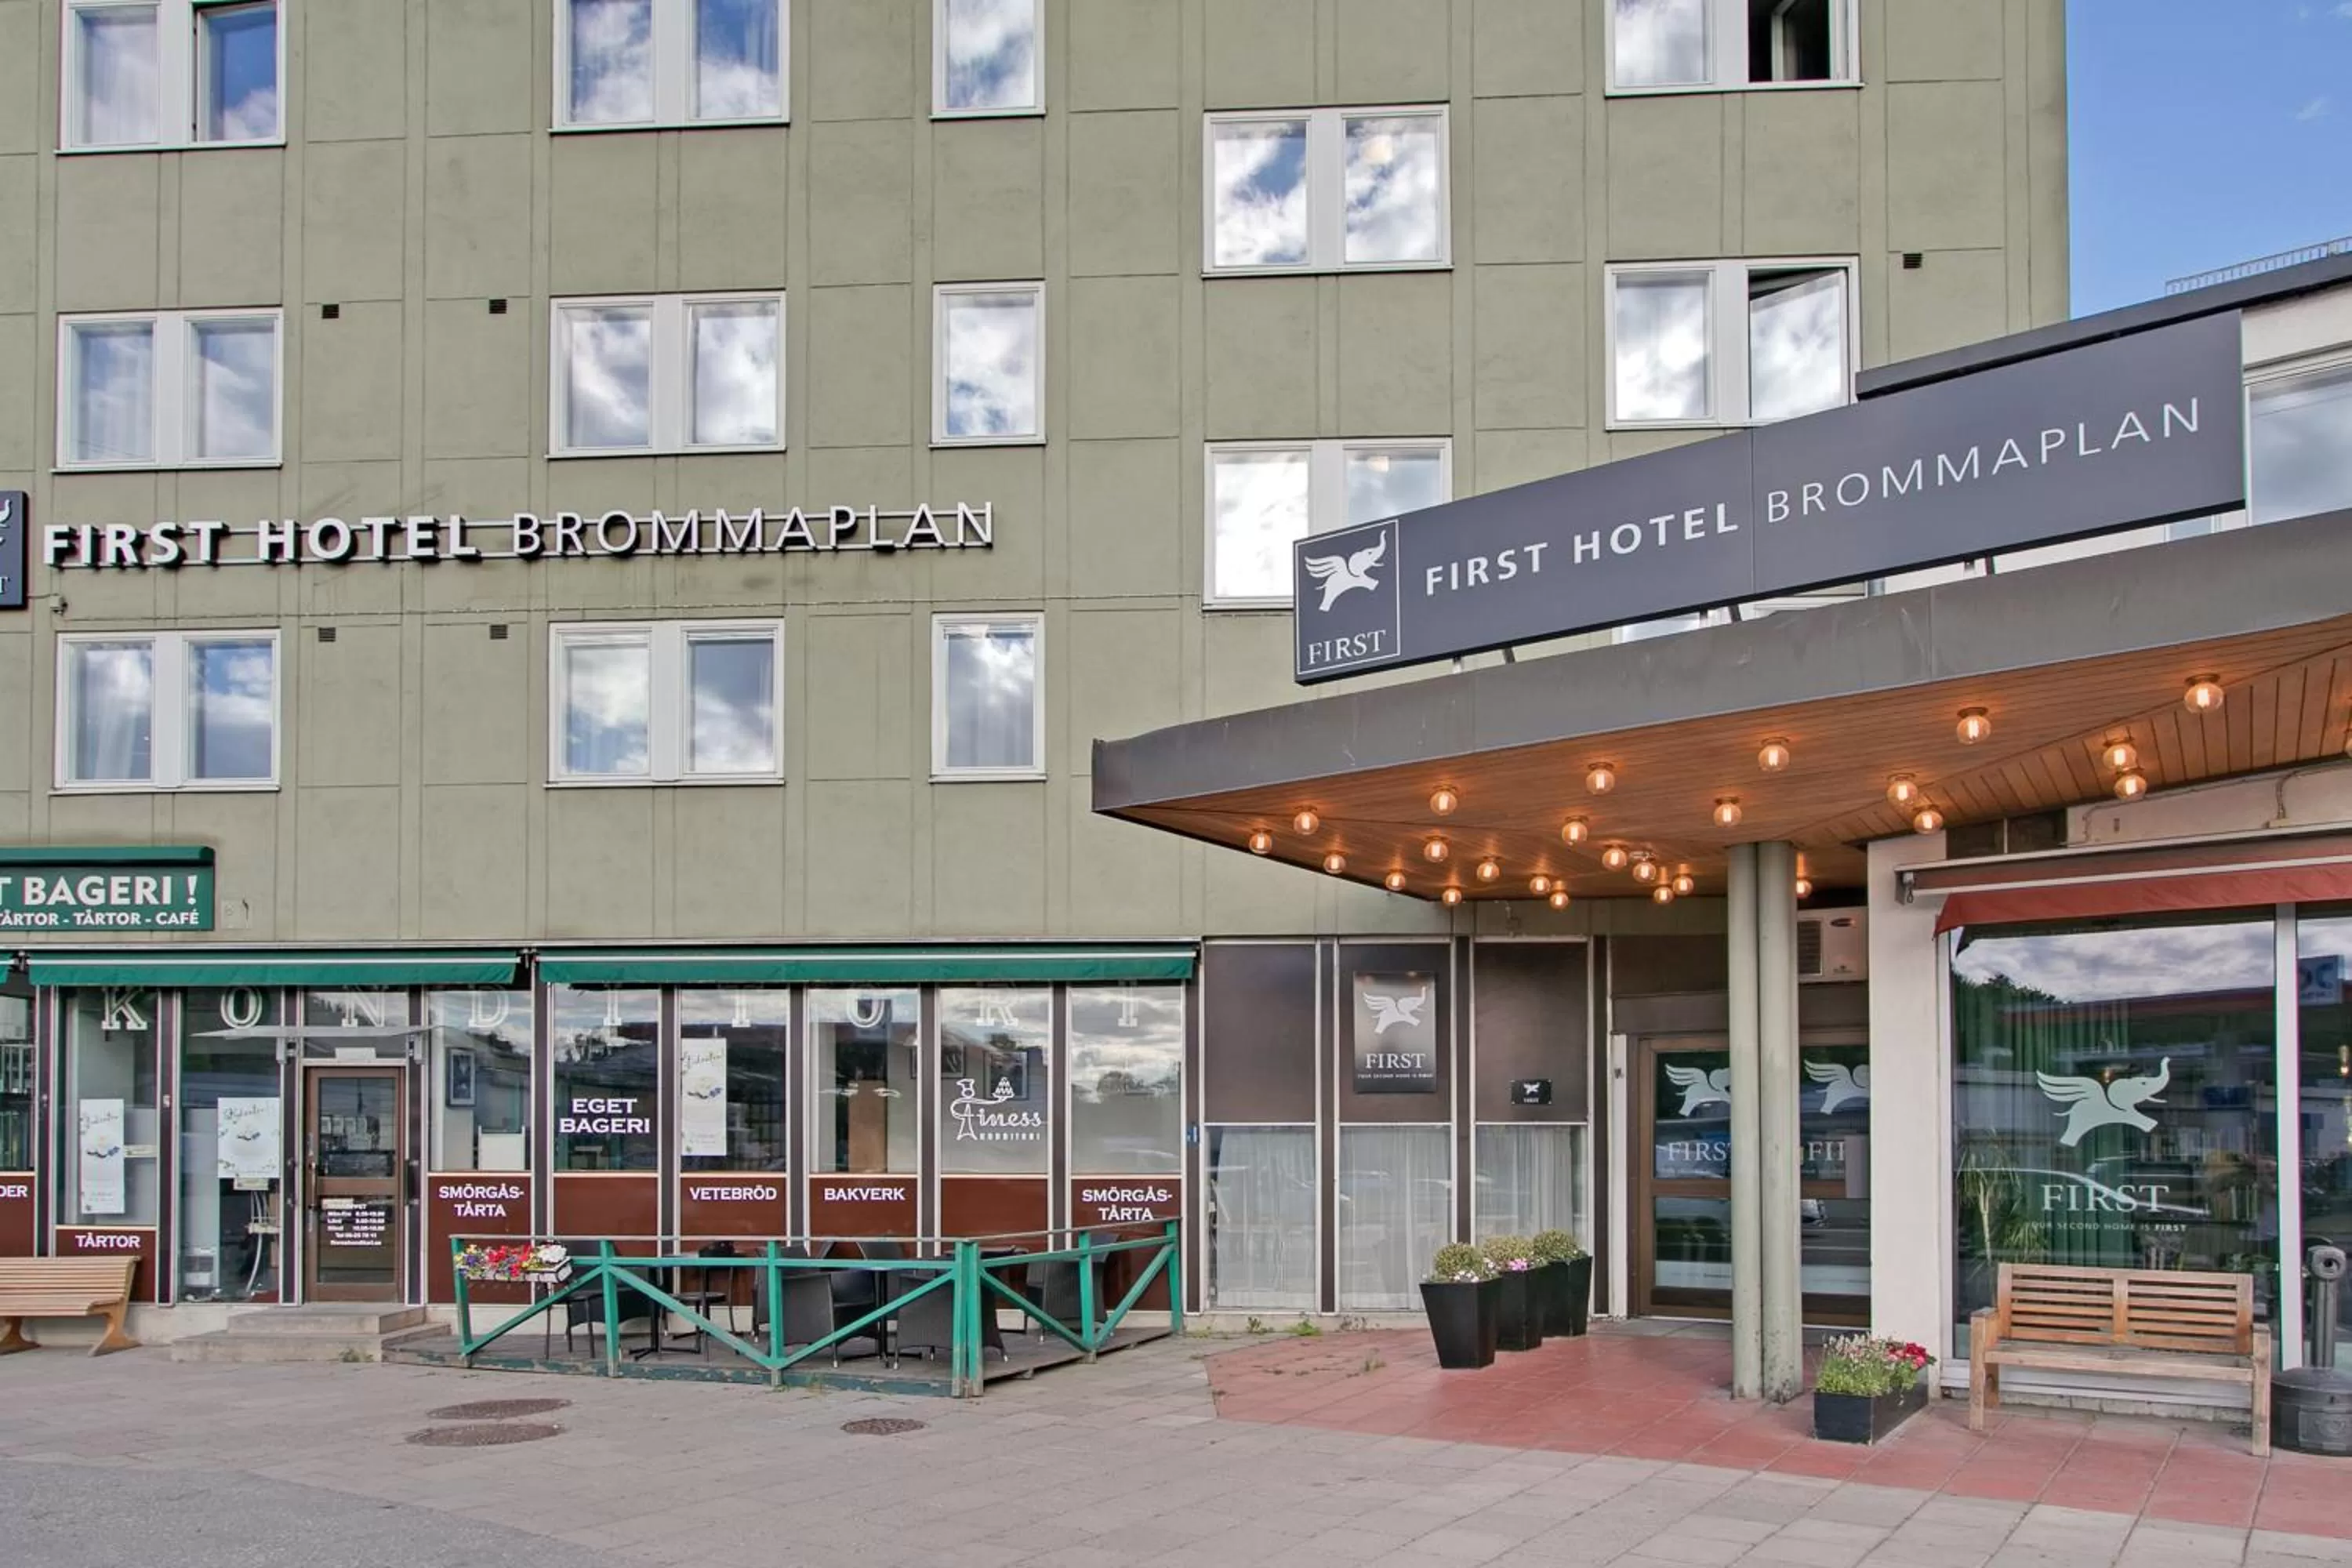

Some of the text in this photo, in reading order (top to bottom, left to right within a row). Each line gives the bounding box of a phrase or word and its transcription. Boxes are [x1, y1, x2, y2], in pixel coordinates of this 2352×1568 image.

[1426, 397, 2198, 596] FIRST HOTEL BROMMAPLAN
[43, 501, 993, 566] FIRST HOTEL BROMMAPLAN
[1308, 630, 1387, 666] FIRST
[24, 876, 172, 906] BAGERI
[0, 909, 59, 926] ÅRTOR
[73, 909, 141, 926] TÅRTOR
[155, 909, 199, 925] CAFÉ
[1365, 1053, 1426, 1069] FIRST
[572, 1098, 638, 1114] EGET
[559, 1118, 651, 1134] BAGERI
[1668, 1142, 1731, 1161] FIRS
[438, 1184, 524, 1200] SMÖRGÅS-
[689, 1185, 777, 1200] VETEBRÖD
[824, 1188, 906, 1200] BAKVERK
[1081, 1186, 1173, 1202] SMÖRGÅS-
[2040, 1185, 2170, 1213] FIRST
[454, 1201, 506, 1217] TÅRTA
[1098, 1205, 1154, 1221] TÅRTA
[74, 1232, 141, 1248] TÅRTOR
